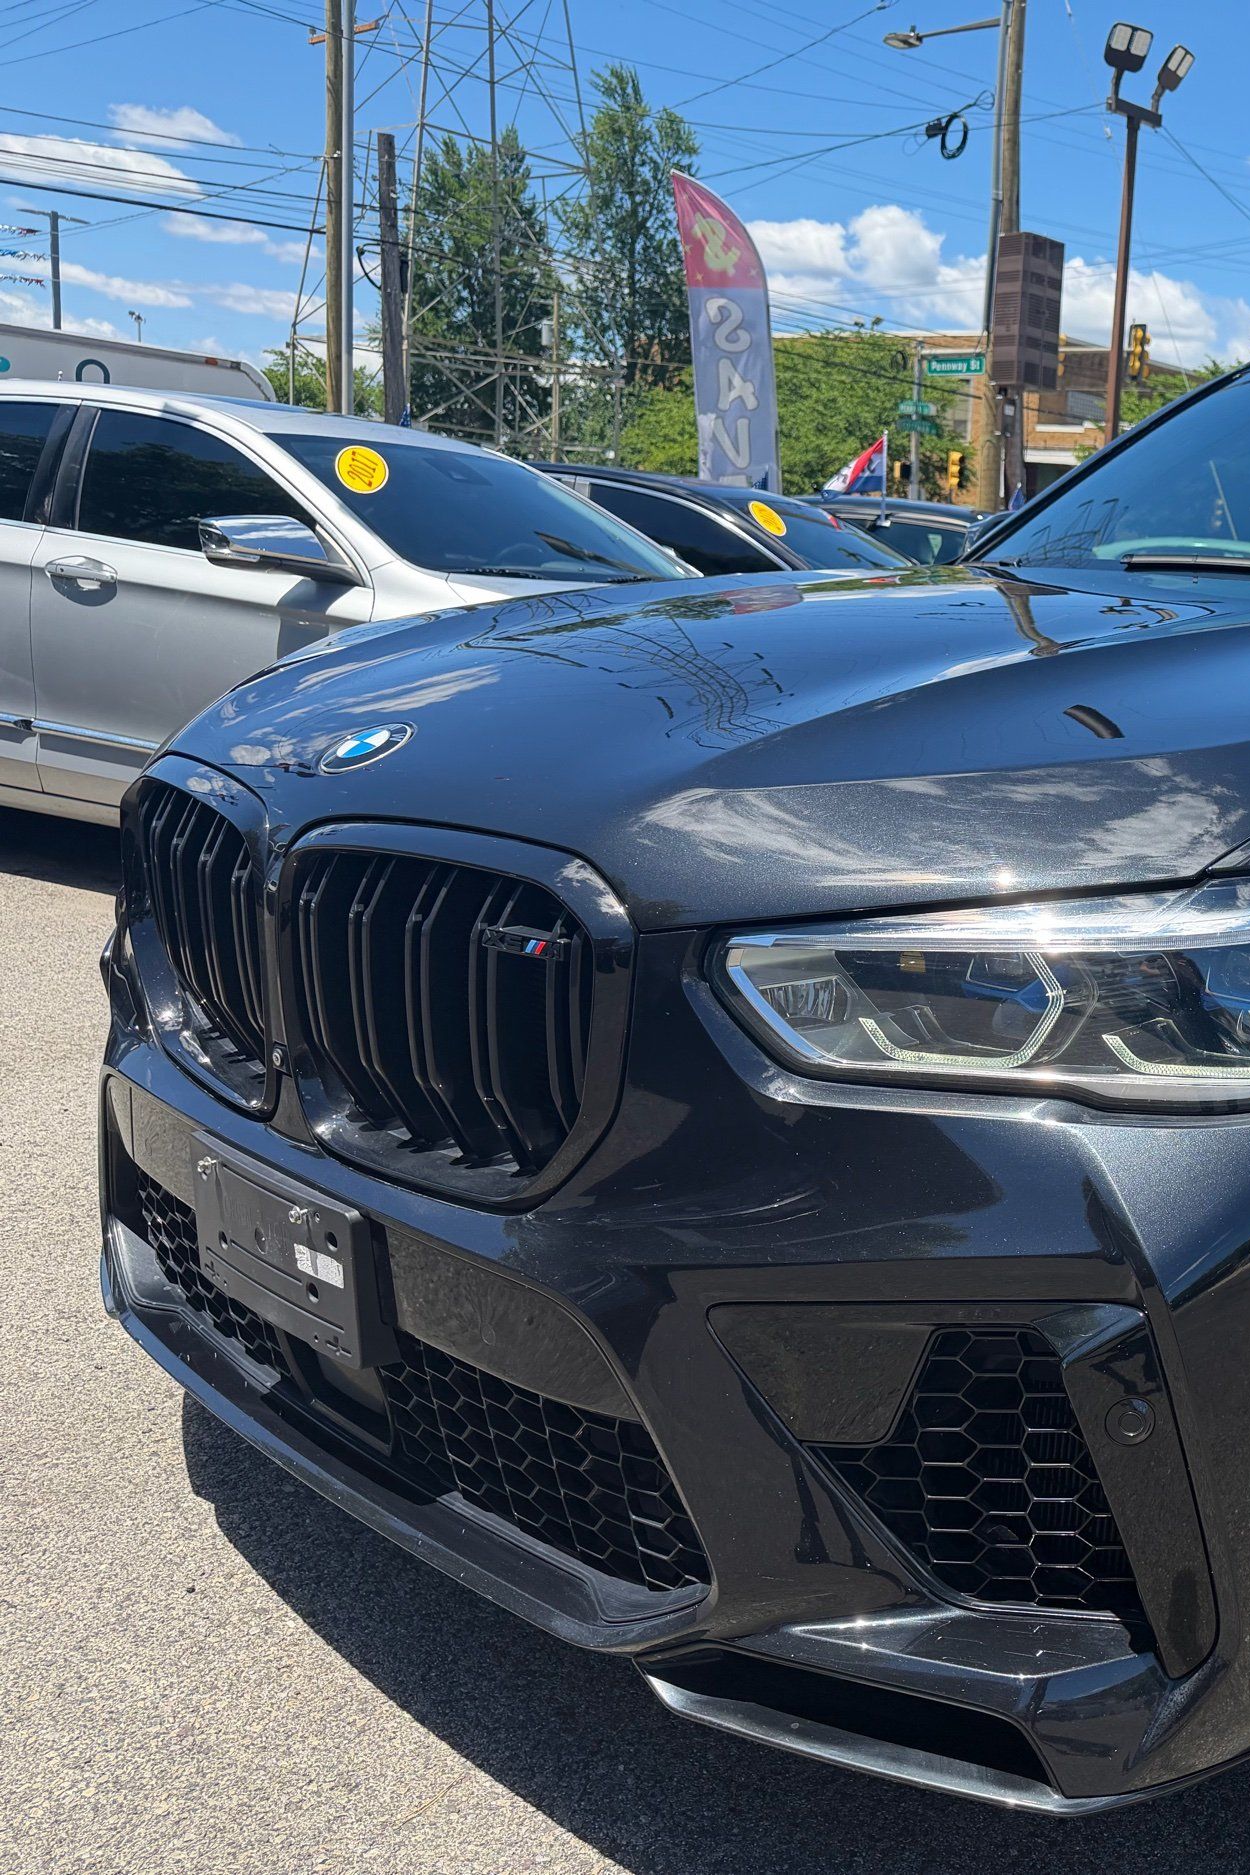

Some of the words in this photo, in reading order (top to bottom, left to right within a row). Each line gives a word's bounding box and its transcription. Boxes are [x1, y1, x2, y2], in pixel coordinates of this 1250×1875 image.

[930, 360, 968, 373] Pennway
[969, 359, 980, 370] St
[347, 450, 379, 488] 2017
